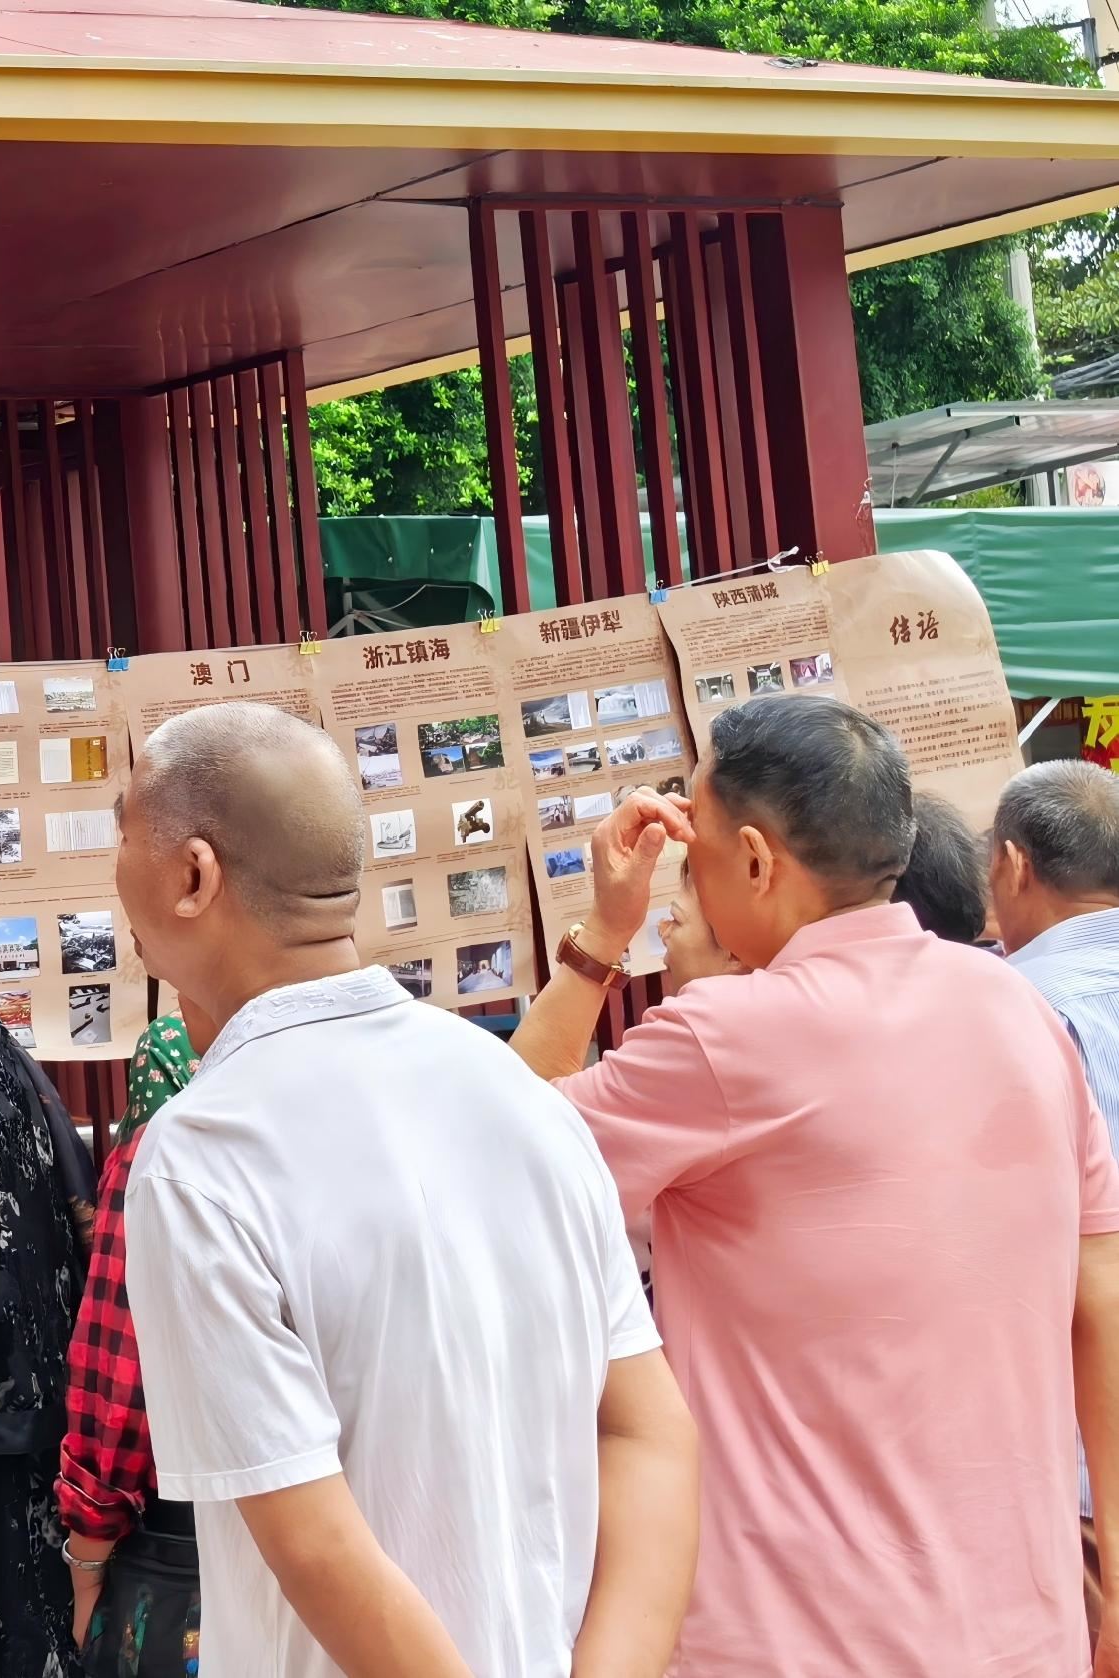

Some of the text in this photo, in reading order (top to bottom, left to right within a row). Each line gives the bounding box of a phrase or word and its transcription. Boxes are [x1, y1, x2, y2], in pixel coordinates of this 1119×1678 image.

[712, 581, 779, 608] 陕西蒲城
[539, 610, 623, 643] 新疆伊犁
[890, 610, 939, 645] 结语
[363, 638, 451, 669] 浙江镇海
[191, 660, 250, 686] 澳门
